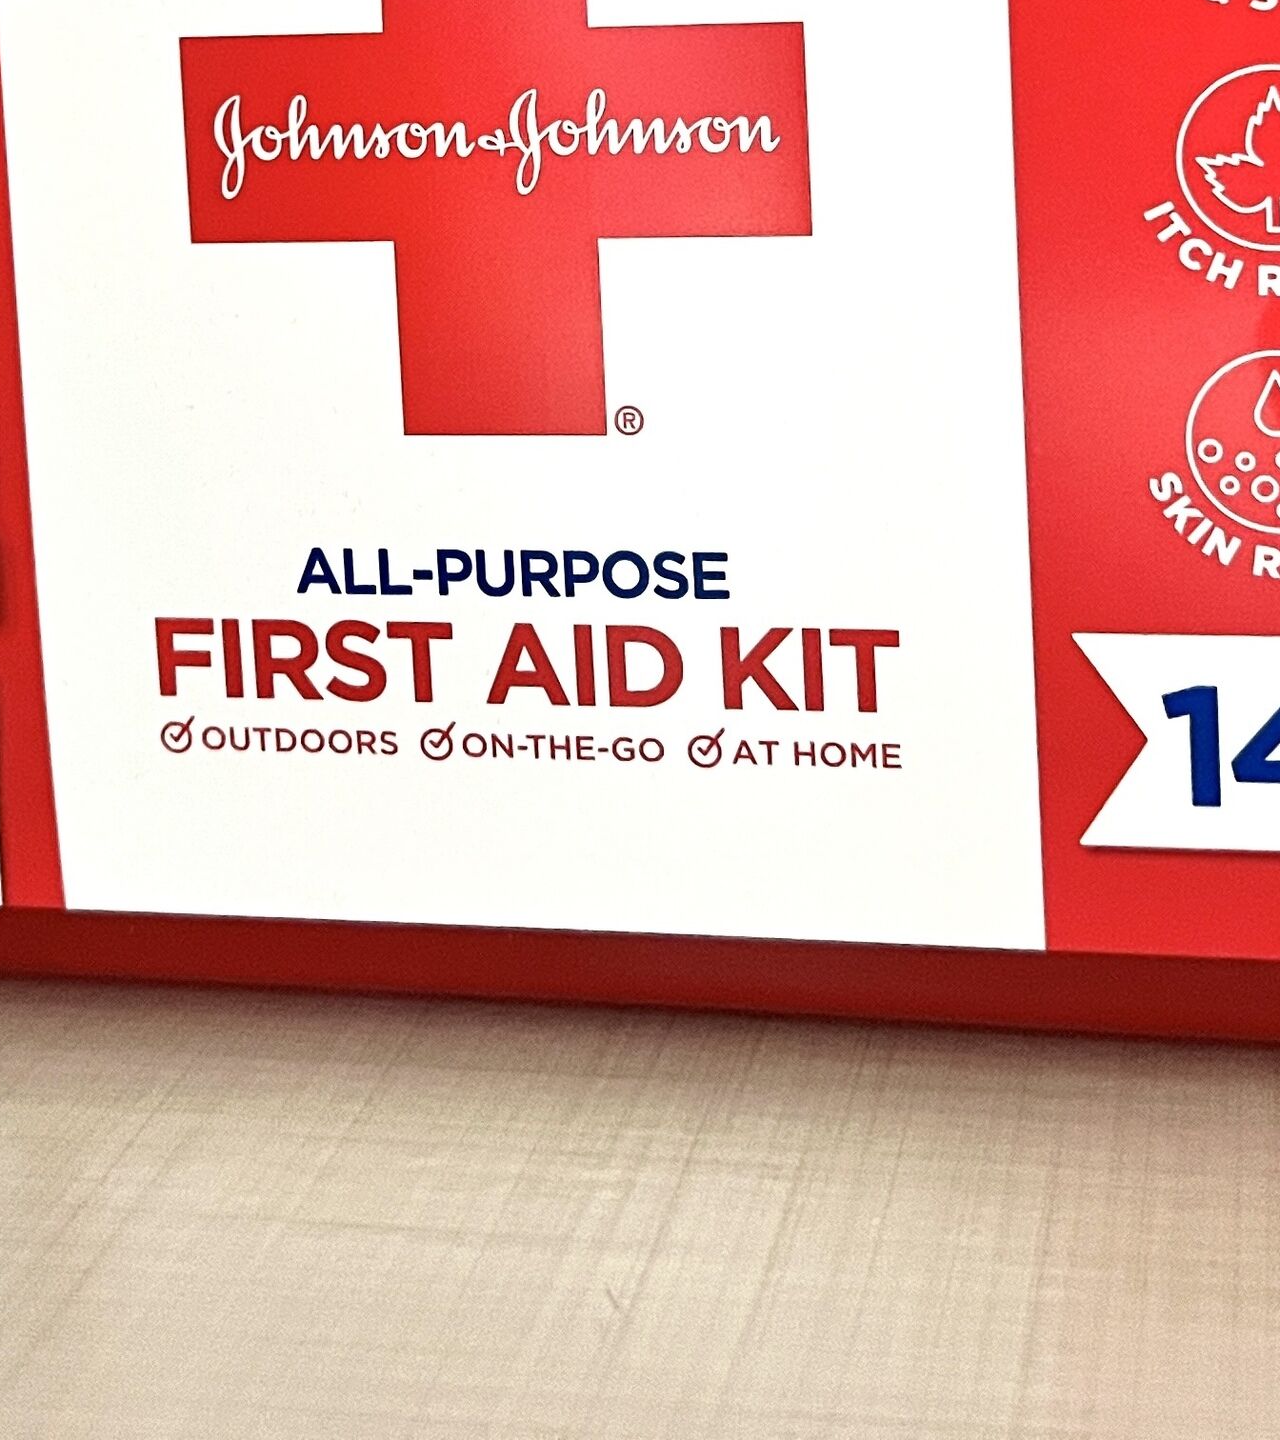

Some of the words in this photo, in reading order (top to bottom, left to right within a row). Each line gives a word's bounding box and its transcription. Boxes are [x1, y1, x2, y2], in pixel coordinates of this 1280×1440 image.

[1143, 200, 1245, 290] ITCH
[1148, 471, 1243, 568] SKIN
[296, 546, 731, 600] ALL-PURPOSE
[153, 616, 454, 704] FIRST
[485, 622, 685, 709] AID
[719, 626, 901, 714] KIT
[201, 725, 400, 757] OUTDOORS
[462, 731, 666, 764] ON-THE-GO
[731, 739, 780, 766] AT
[793, 740, 903, 771] HOME
